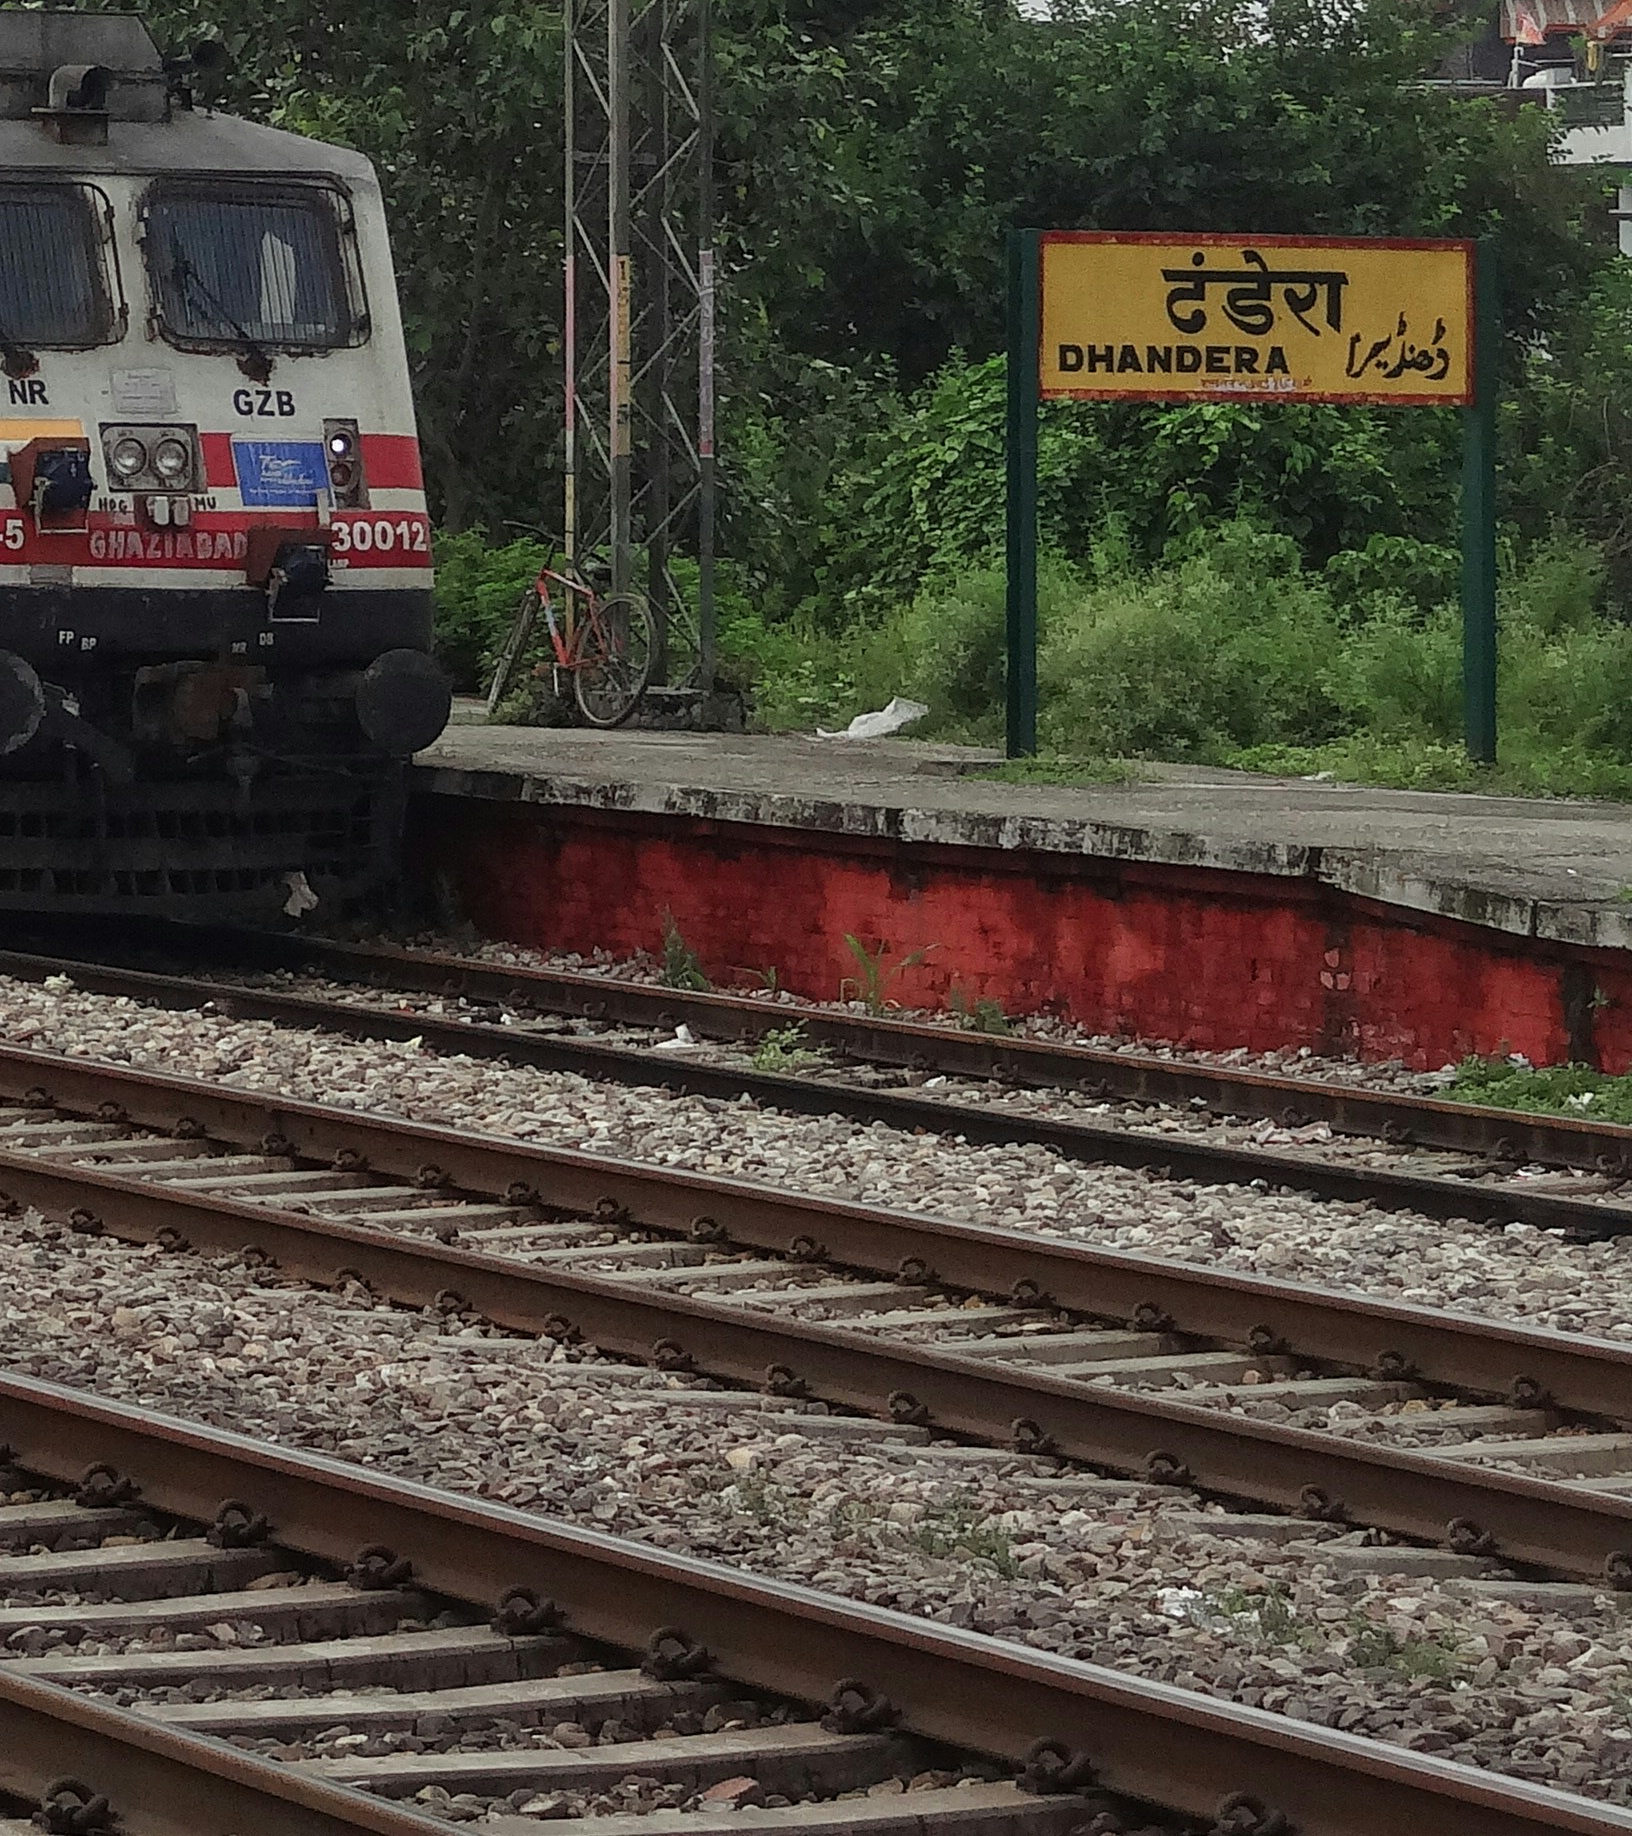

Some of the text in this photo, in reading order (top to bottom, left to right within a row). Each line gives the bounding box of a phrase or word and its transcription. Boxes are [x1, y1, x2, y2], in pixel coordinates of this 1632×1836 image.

[1161, 250, 1349, 336] ढंडेरा
[1058, 344, 1291, 375] DHANDERA
[8, 379, 49, 405] NR
[233, 388, 296, 416] GZB
[193, 496, 217, 511] MU
[89, 529, 249, 560] GHAZIABAD
[330, 519, 428, 552] 30012
[58, 630, 75, 645] FP
[80, 637, 97, 651] BP
